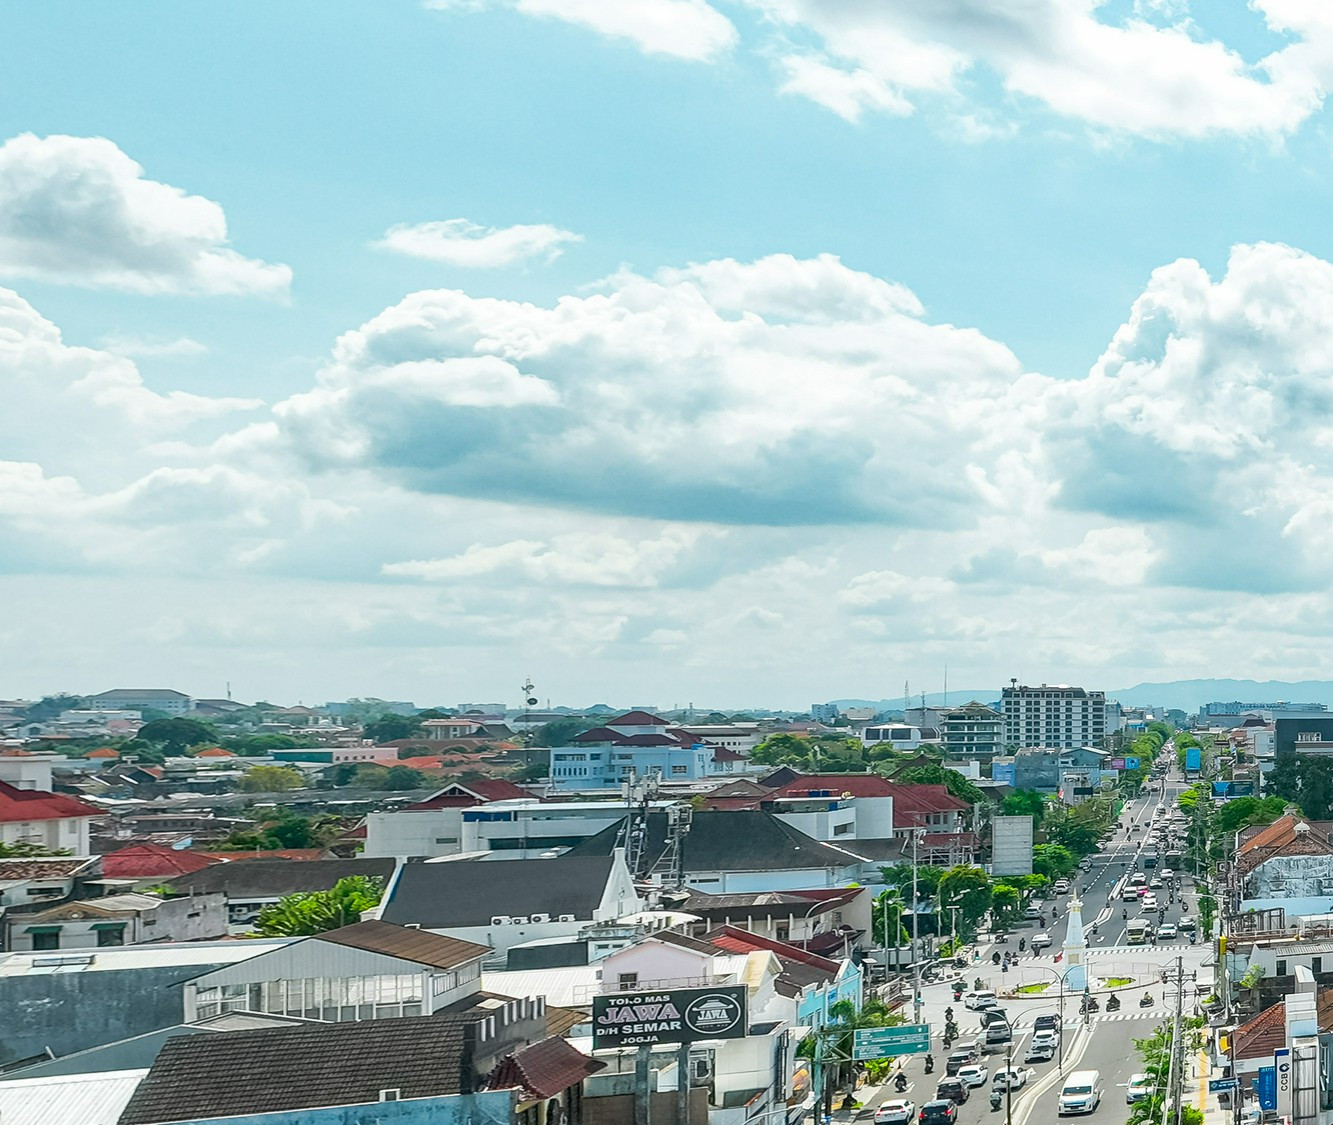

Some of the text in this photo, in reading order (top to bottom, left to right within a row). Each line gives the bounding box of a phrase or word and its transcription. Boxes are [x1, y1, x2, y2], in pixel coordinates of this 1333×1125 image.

[644, 994, 671, 1003] MAS
[598, 1003, 680, 1024] JAWA
[698, 1009, 728, 1020] JAWA
[596, 1020, 682, 1036] D/H SEMAR
[620, 1034, 659, 1045] JOGJA
